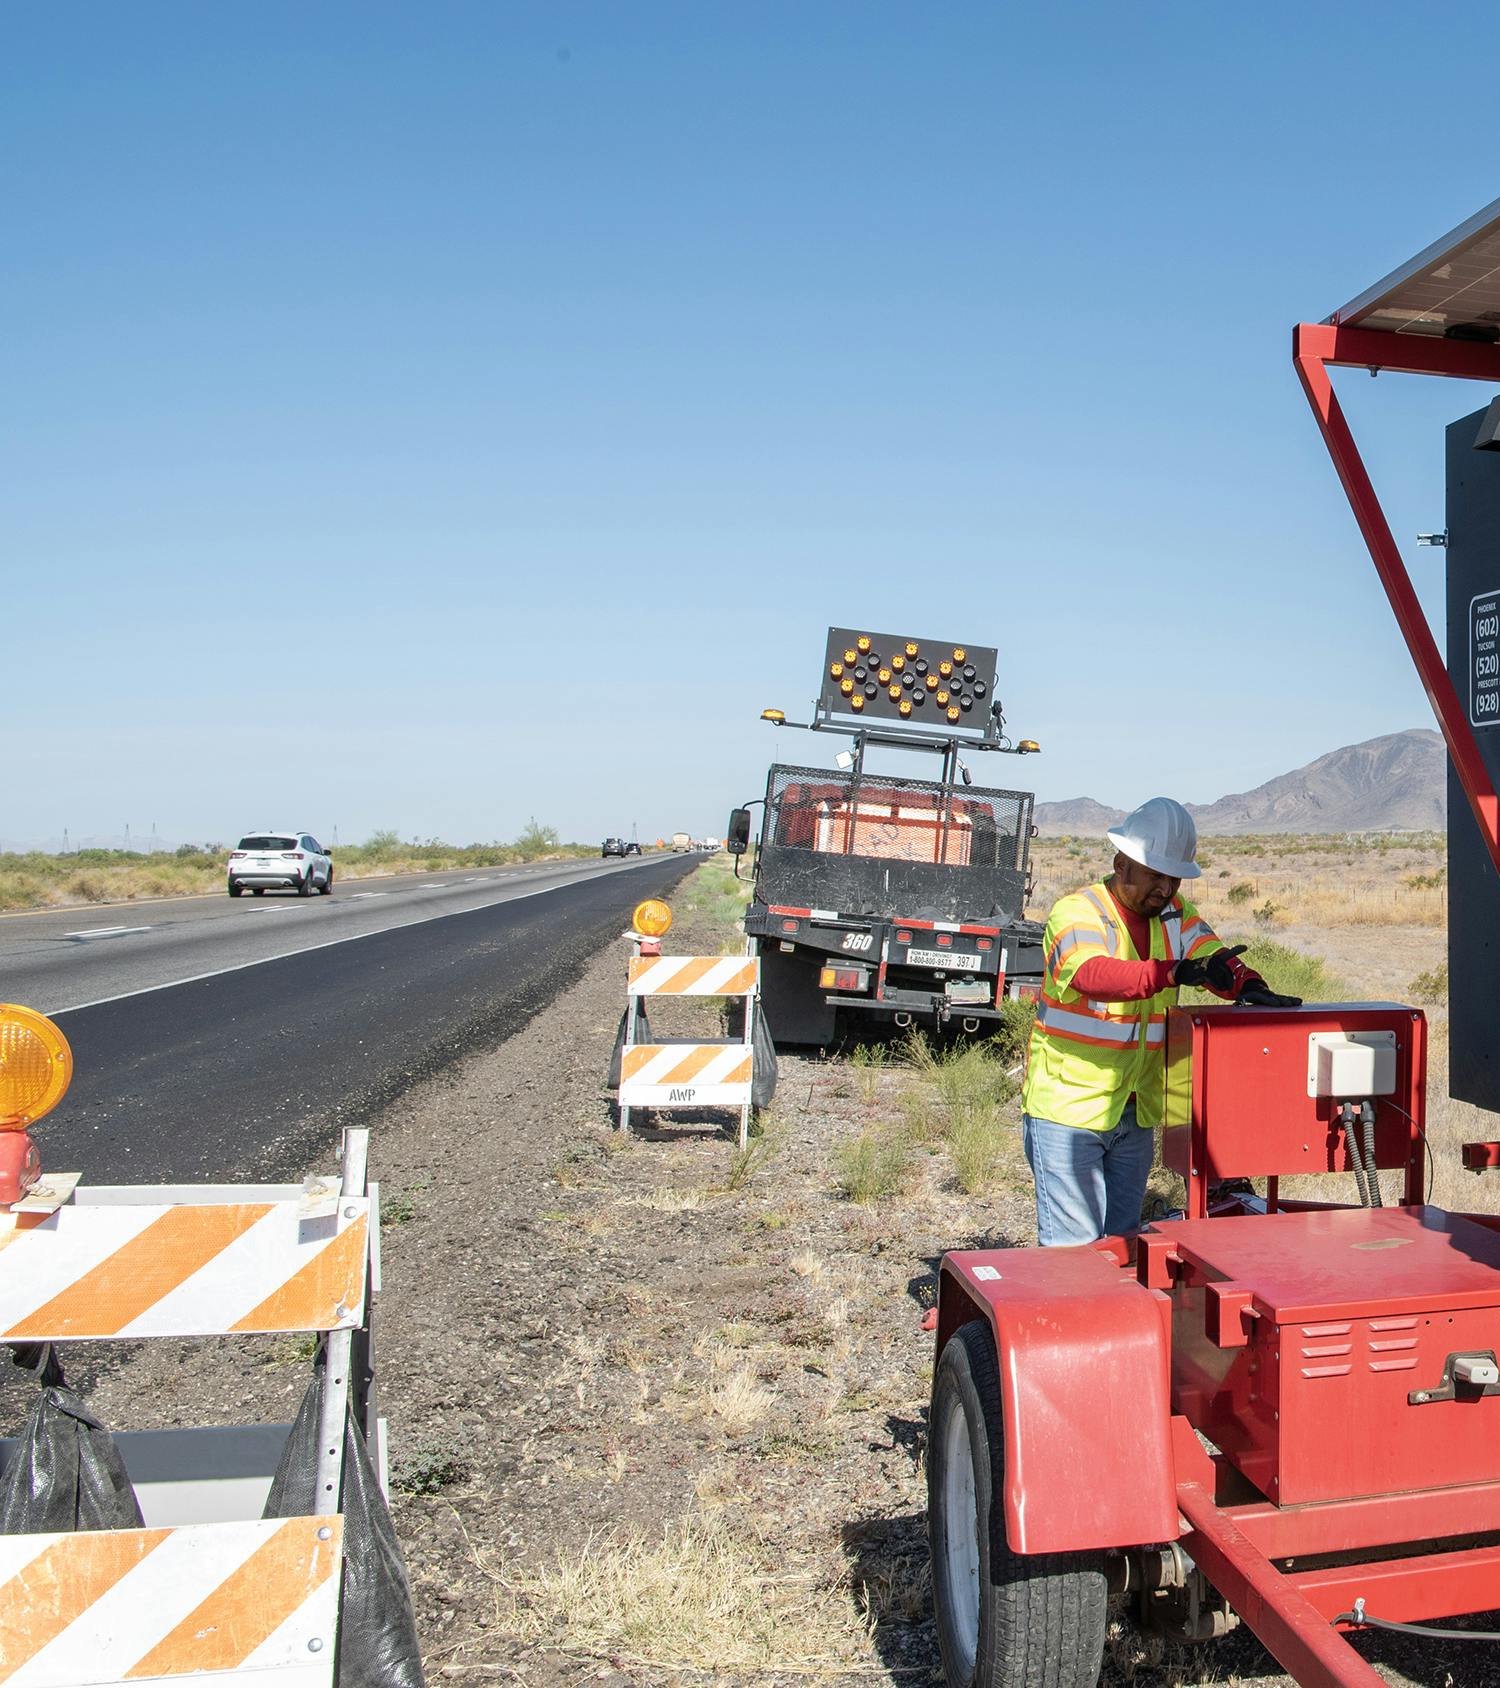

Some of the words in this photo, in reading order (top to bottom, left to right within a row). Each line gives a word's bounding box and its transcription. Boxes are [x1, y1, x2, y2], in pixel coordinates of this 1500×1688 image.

[1477, 602, 1497, 614] PHOENIX
[1475, 615, 1499, 641] (602)
[1477, 640, 1495, 652] TUCSON
[1475, 653, 1499, 678] (520)
[1477, 677, 1499, 689] PRESCOTT
[1475, 691, 1499, 716] (928)
[842, 933, 873, 950] 360
[956, 956, 970, 968] 397
[668, 1088, 696, 1102] AWP
